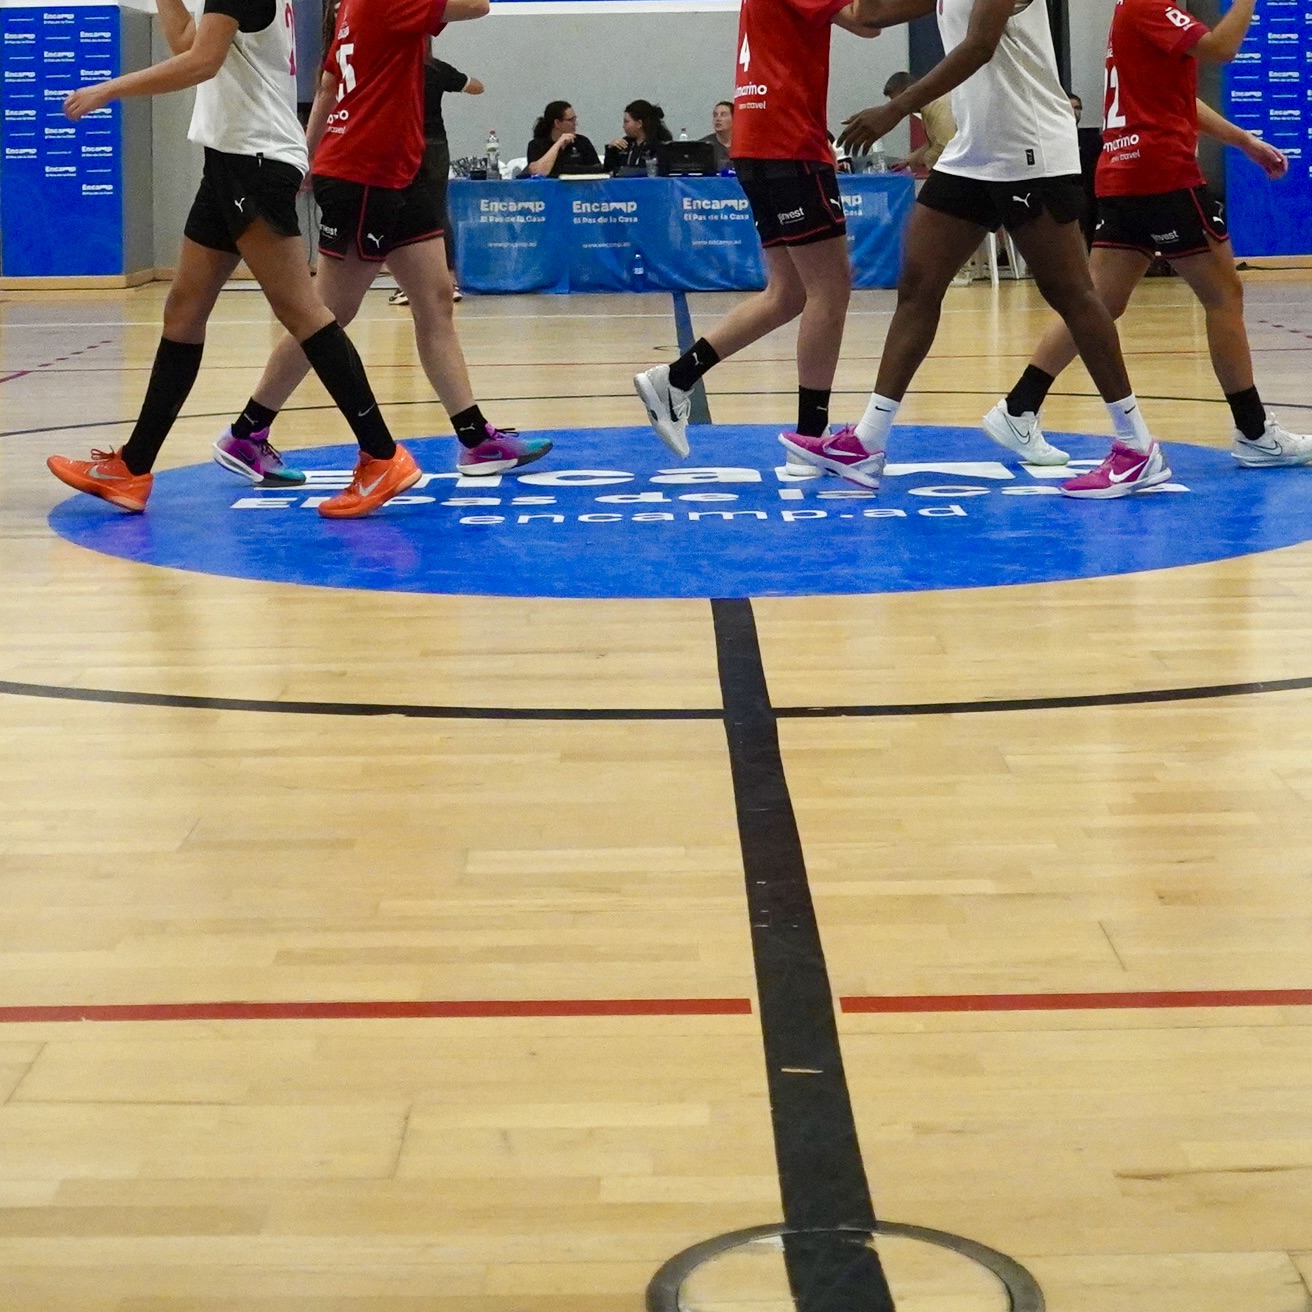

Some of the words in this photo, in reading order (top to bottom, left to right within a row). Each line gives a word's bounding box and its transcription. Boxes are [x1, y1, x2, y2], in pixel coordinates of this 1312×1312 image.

[480, 199, 545, 212] Encamp
[573, 201, 637, 213] Encamp
[683, 197, 749, 210] Encamp
[595, 491, 739, 503] de
[459, 504, 969, 525] encamp.ad
